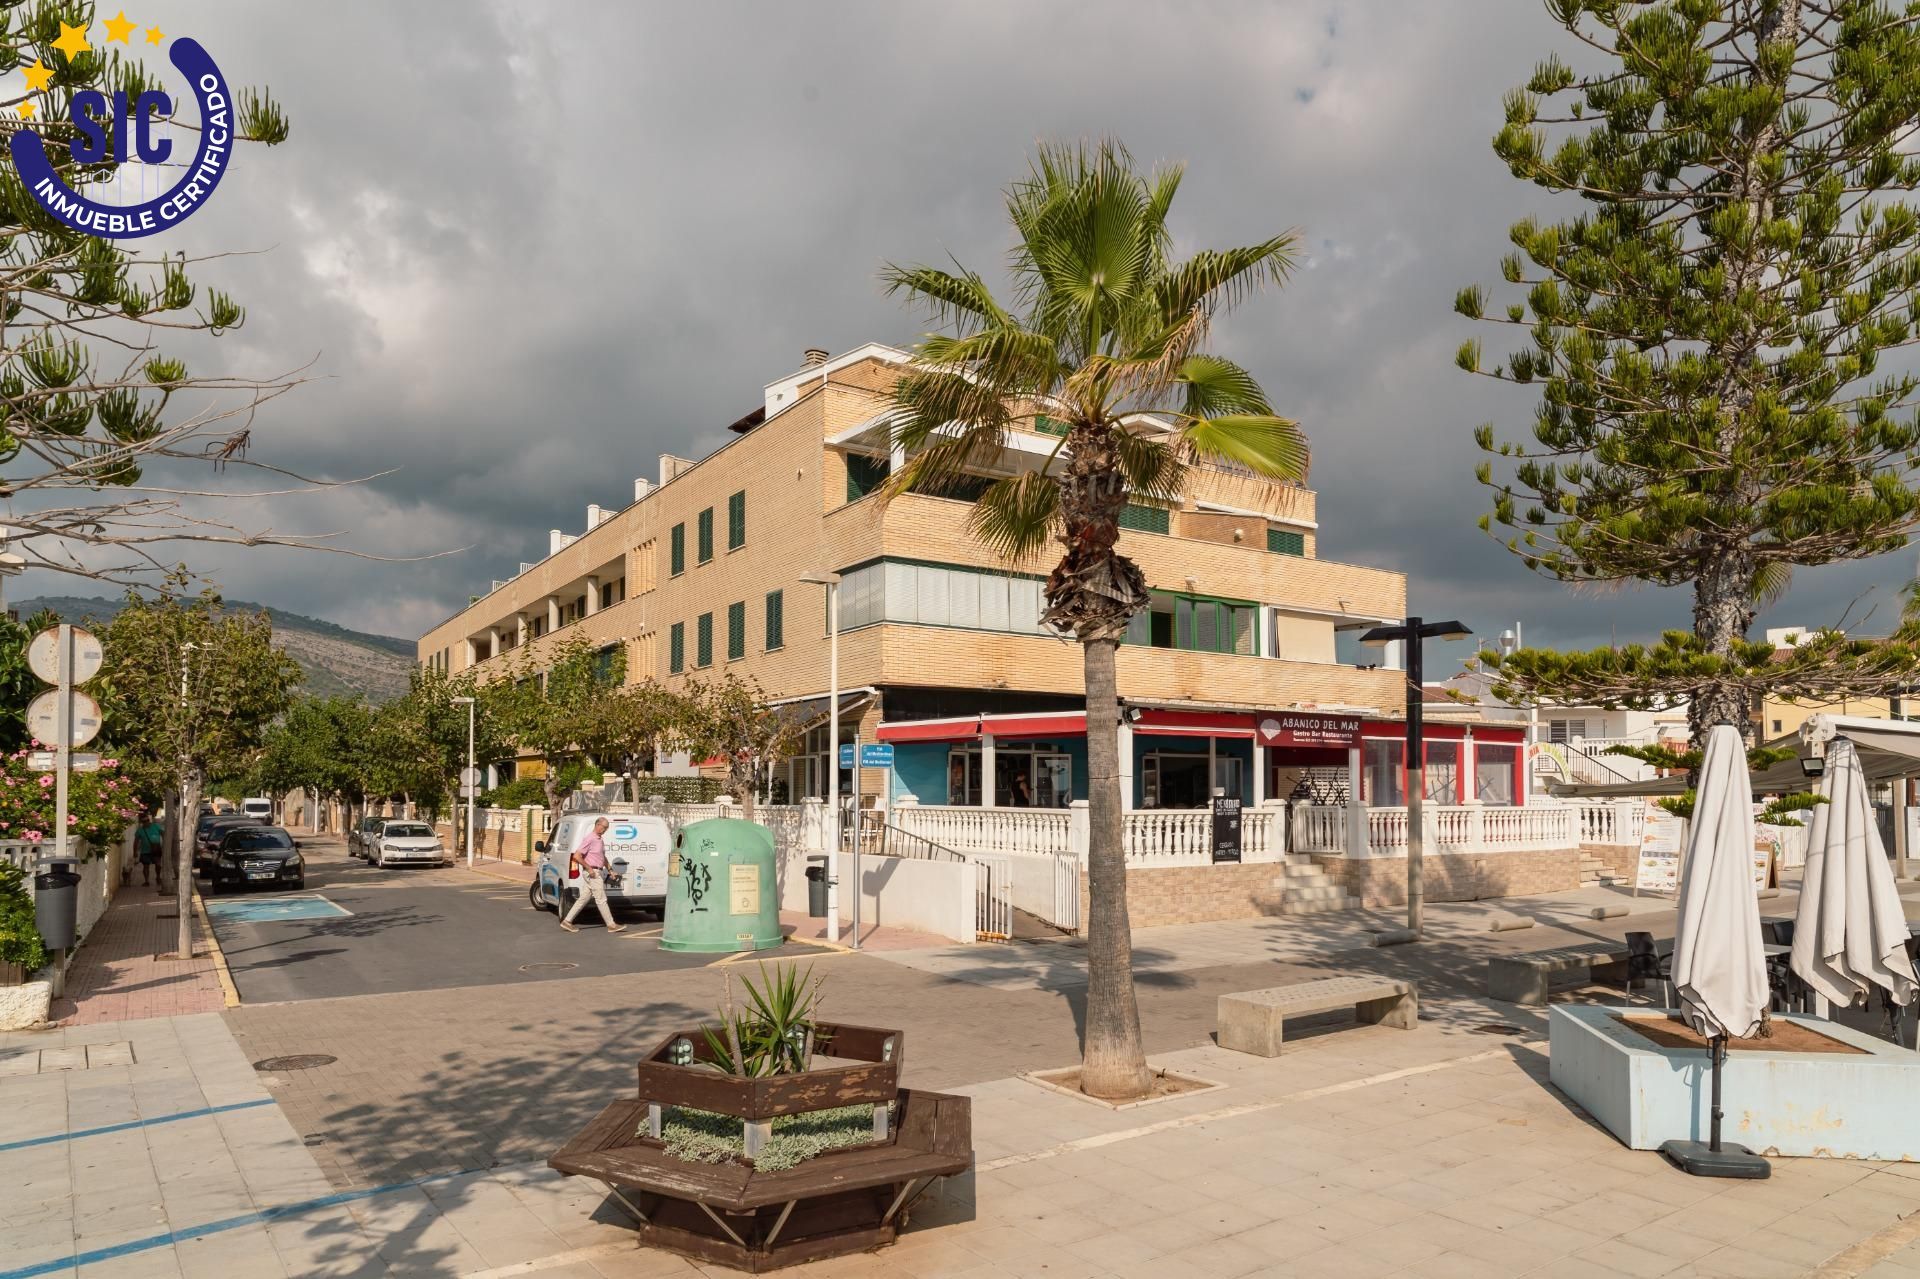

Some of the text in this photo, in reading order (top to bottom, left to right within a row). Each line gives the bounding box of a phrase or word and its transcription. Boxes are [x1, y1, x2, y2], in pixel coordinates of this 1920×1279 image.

[1282, 718, 1359, 731] ABANICO DEL MAR
